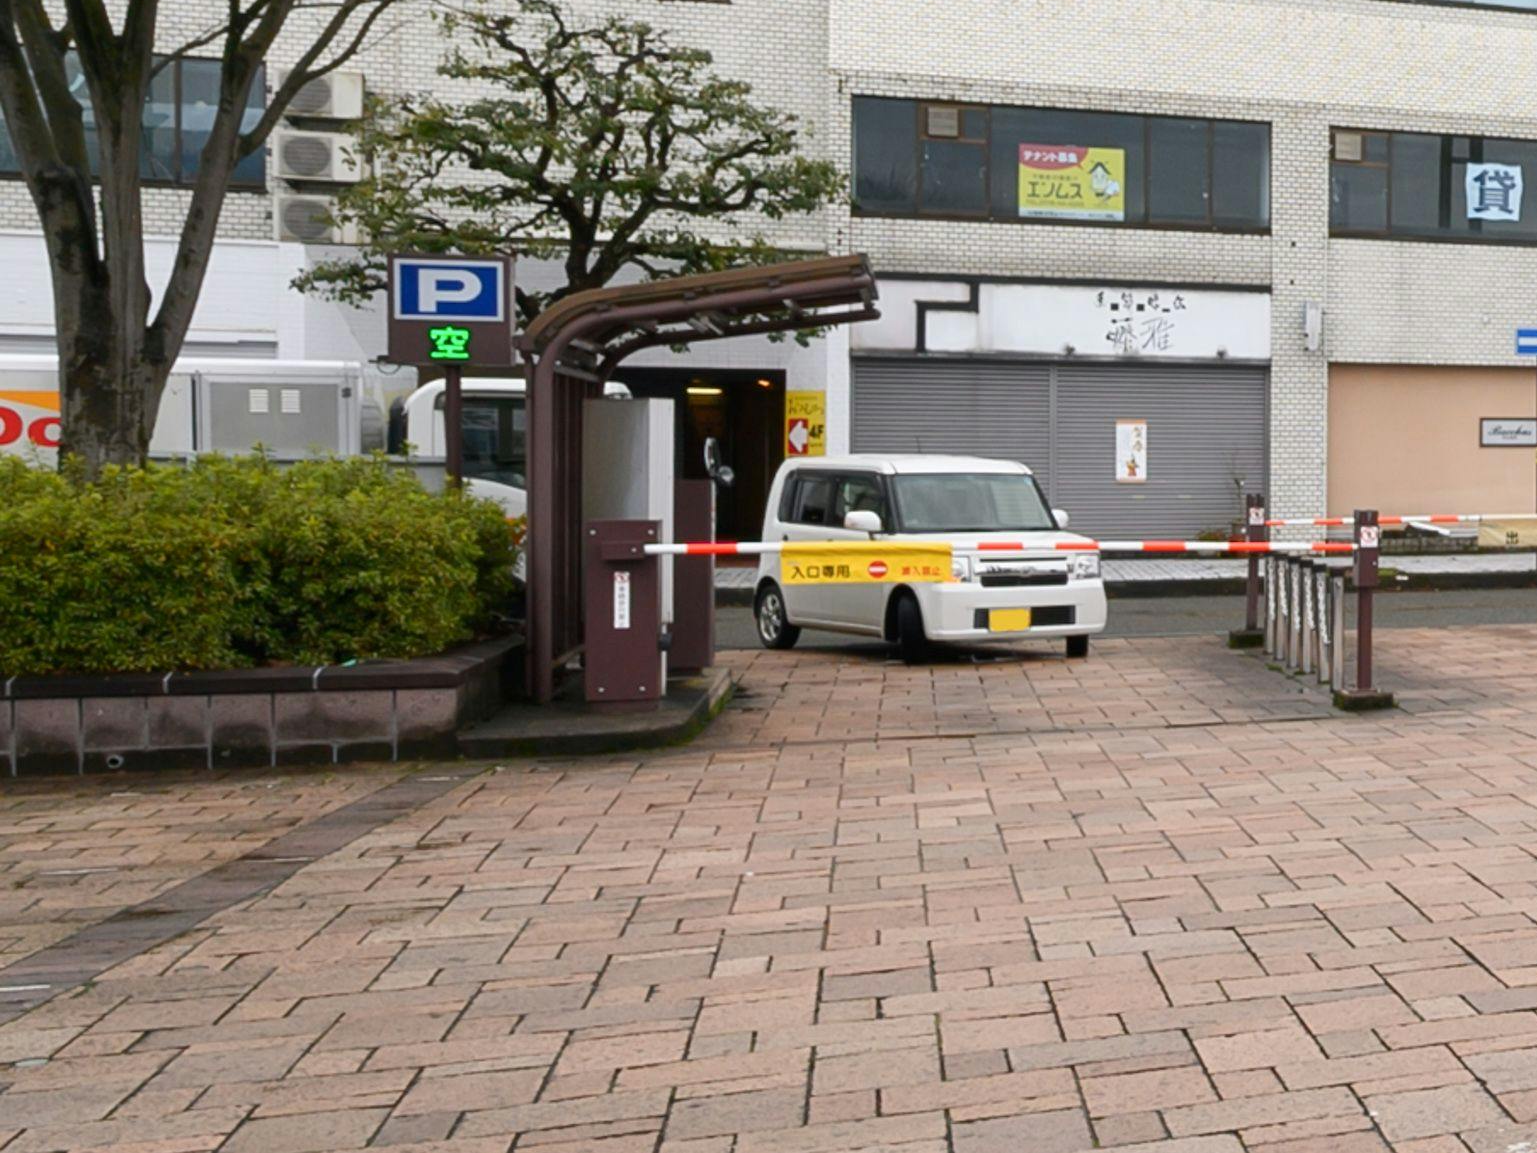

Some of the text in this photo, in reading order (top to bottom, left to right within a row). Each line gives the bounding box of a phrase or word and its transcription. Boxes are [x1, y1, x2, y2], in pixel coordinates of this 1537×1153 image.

[1472, 169, 1517, 215] 貸
[418, 268, 482, 313] P
[430, 326, 469, 359] 空
[791, 565, 851, 579] 入口専用
